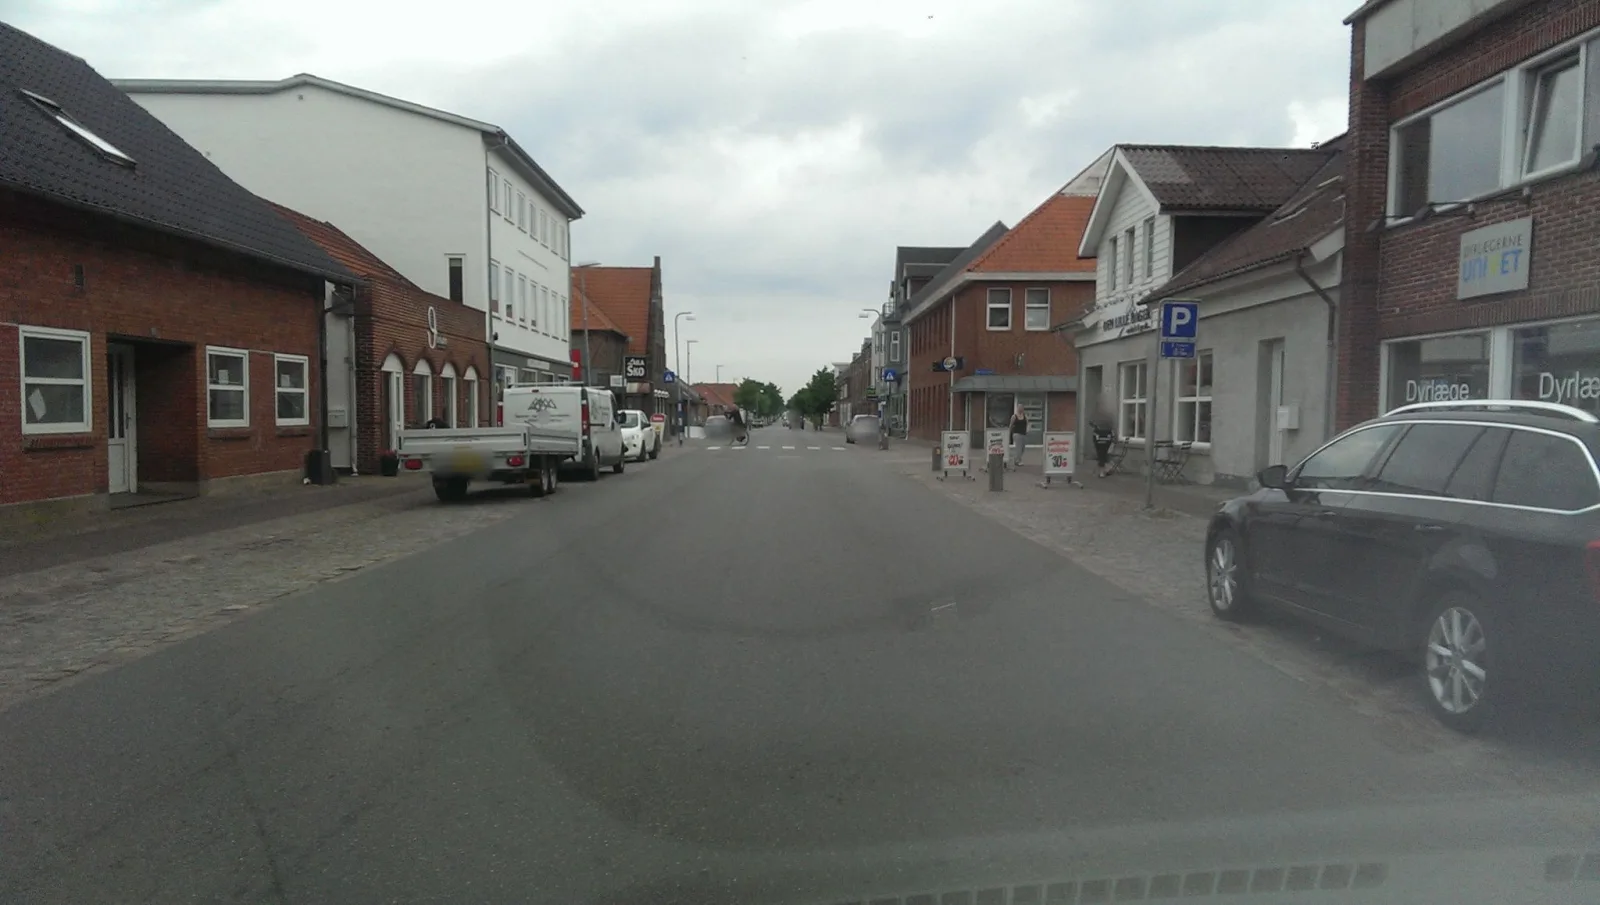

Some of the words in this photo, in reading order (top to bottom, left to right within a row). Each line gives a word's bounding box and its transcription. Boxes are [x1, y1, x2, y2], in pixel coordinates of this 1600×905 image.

[1170, 306, 1192, 335] P
[626, 366, 645, 377] SKO
[1405, 380, 1470, 402] Dyrlæge
